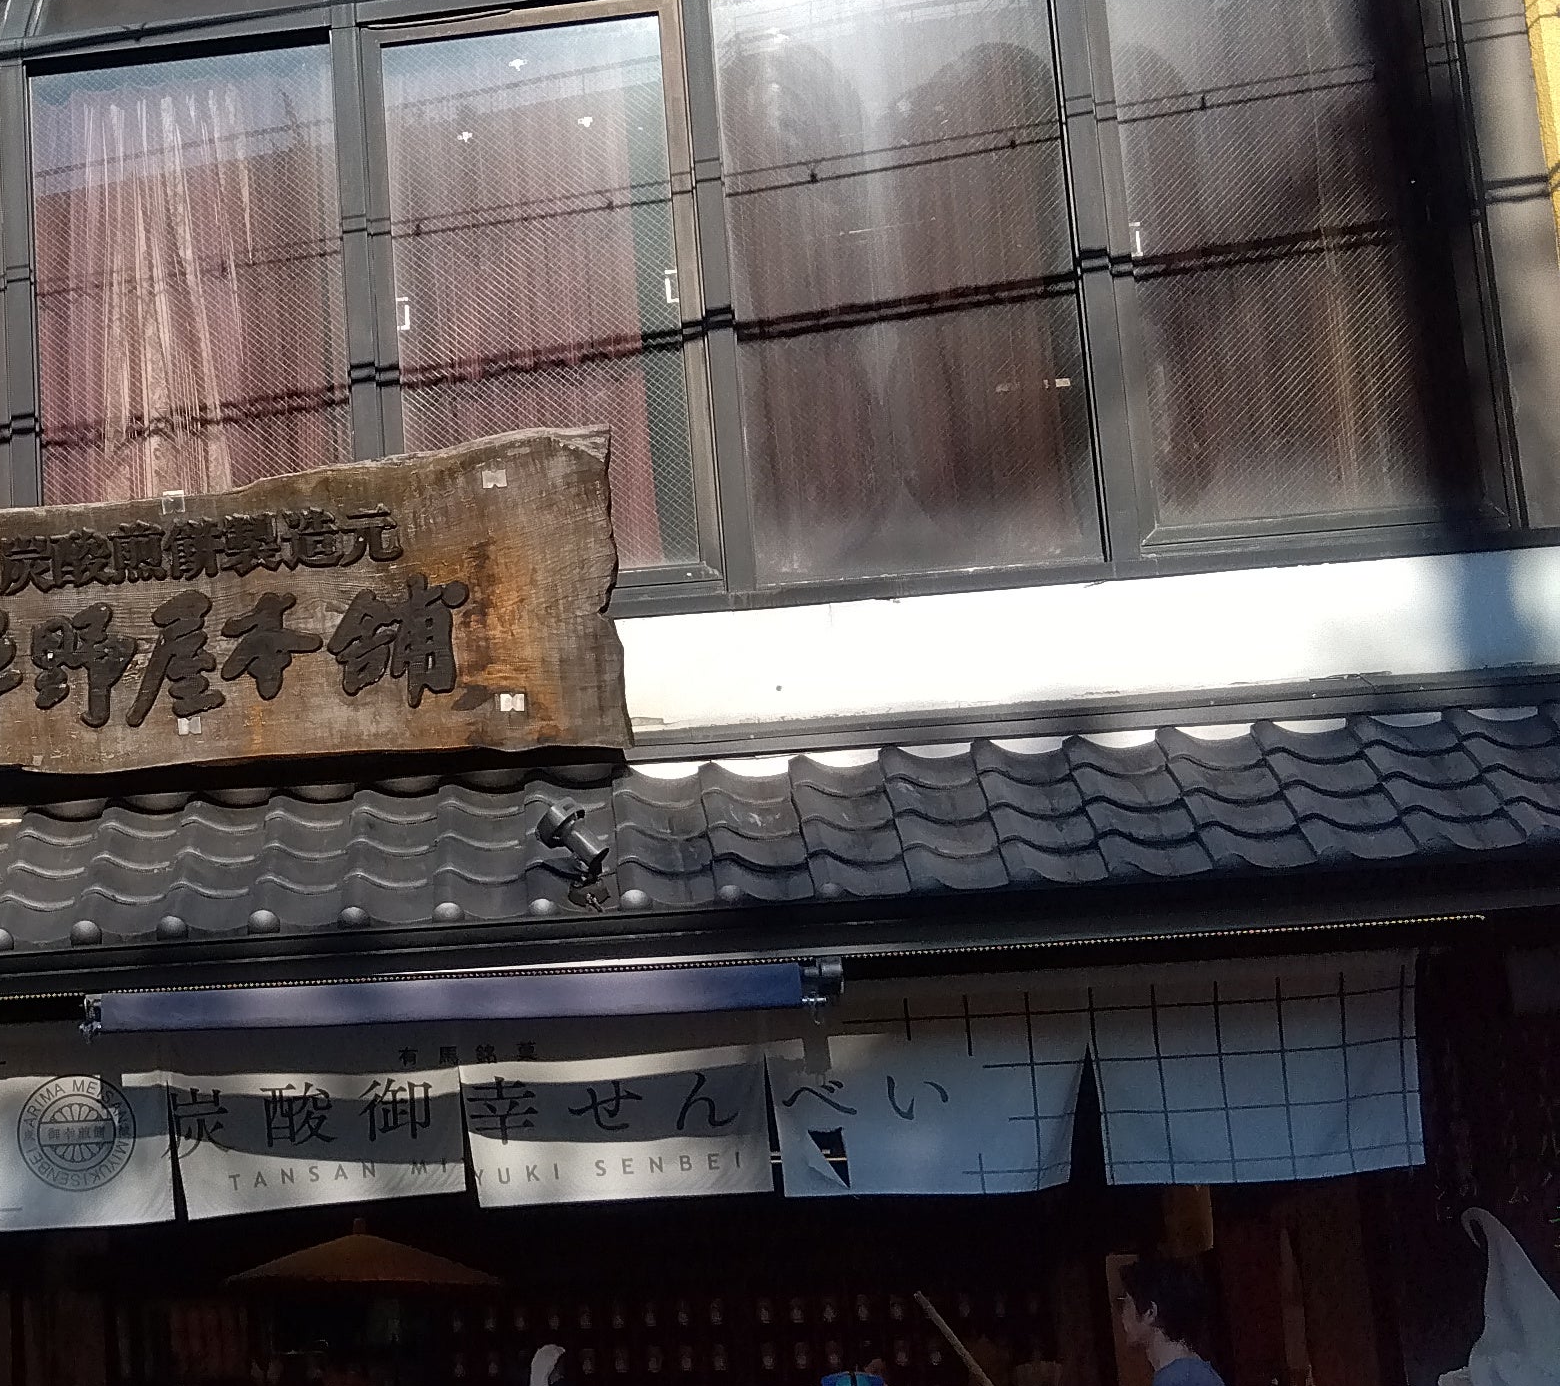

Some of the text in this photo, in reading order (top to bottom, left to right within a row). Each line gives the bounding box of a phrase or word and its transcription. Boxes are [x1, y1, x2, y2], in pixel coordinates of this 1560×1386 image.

[161, 1072, 950, 1160] 炭酸御幸せんべい
[228, 1159, 378, 1191] TANSAN
[594, 1151, 744, 1178] SENBEI
